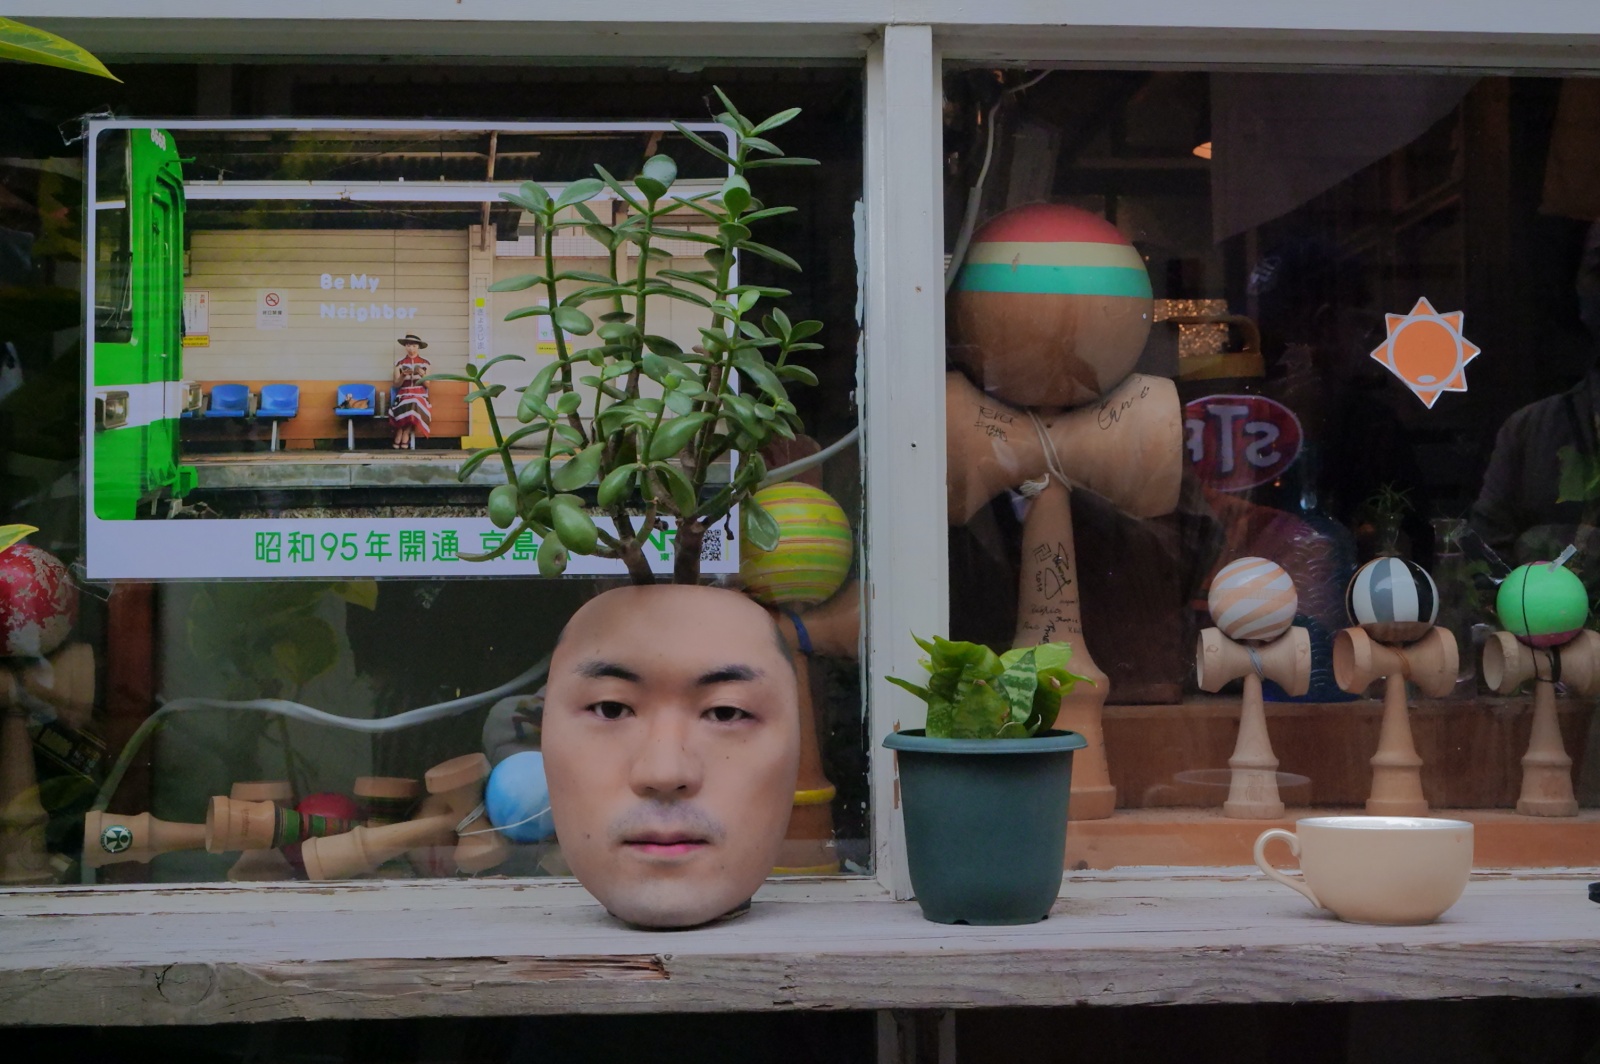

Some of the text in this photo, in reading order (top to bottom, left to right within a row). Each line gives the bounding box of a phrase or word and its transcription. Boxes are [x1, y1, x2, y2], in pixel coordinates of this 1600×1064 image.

[320, 273, 380, 294] Be My
[320, 303, 418, 322] Neighbor
[255, 530, 460, 563] 昭和95年開通
